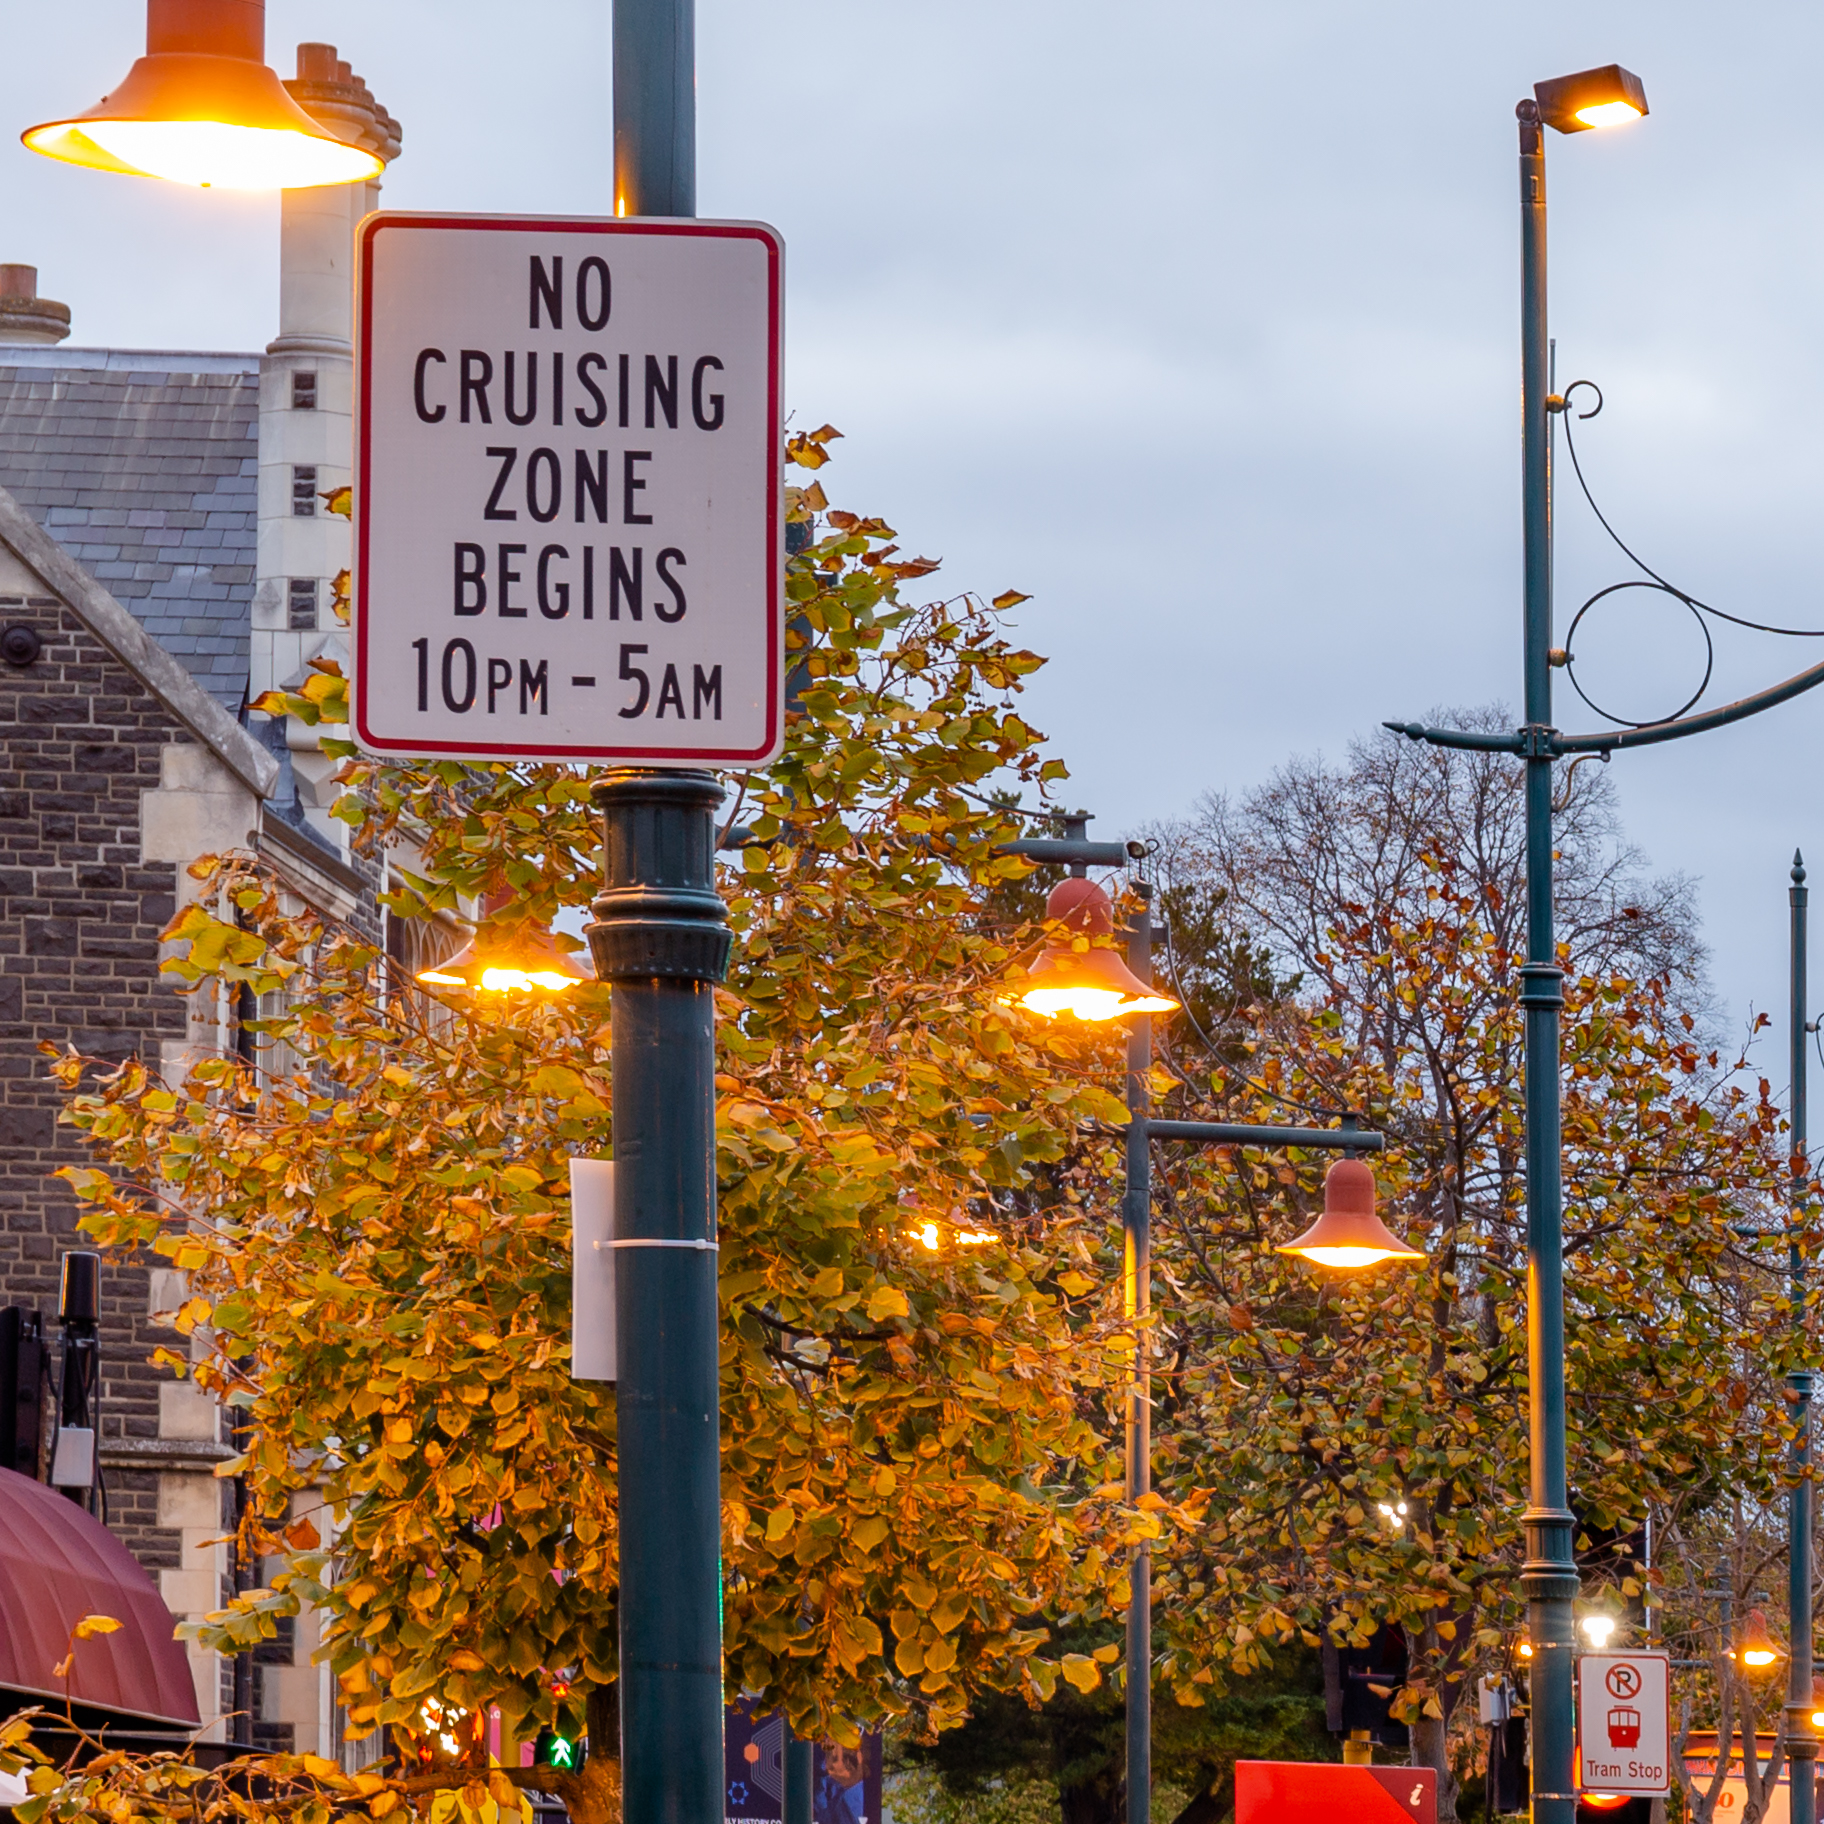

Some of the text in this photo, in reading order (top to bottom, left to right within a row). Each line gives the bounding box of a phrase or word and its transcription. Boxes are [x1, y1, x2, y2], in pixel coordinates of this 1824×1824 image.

[529, 255, 611, 331] NO
[413, 348, 725, 431] CRUISING
[484, 446, 653, 525] ZONE
[453, 542, 687, 623] BEGINS
[411, 637, 549, 715] 10PM
[617, 643, 723, 720] 5AM
[1587, 1760, 1663, 1781] Tram Stop
